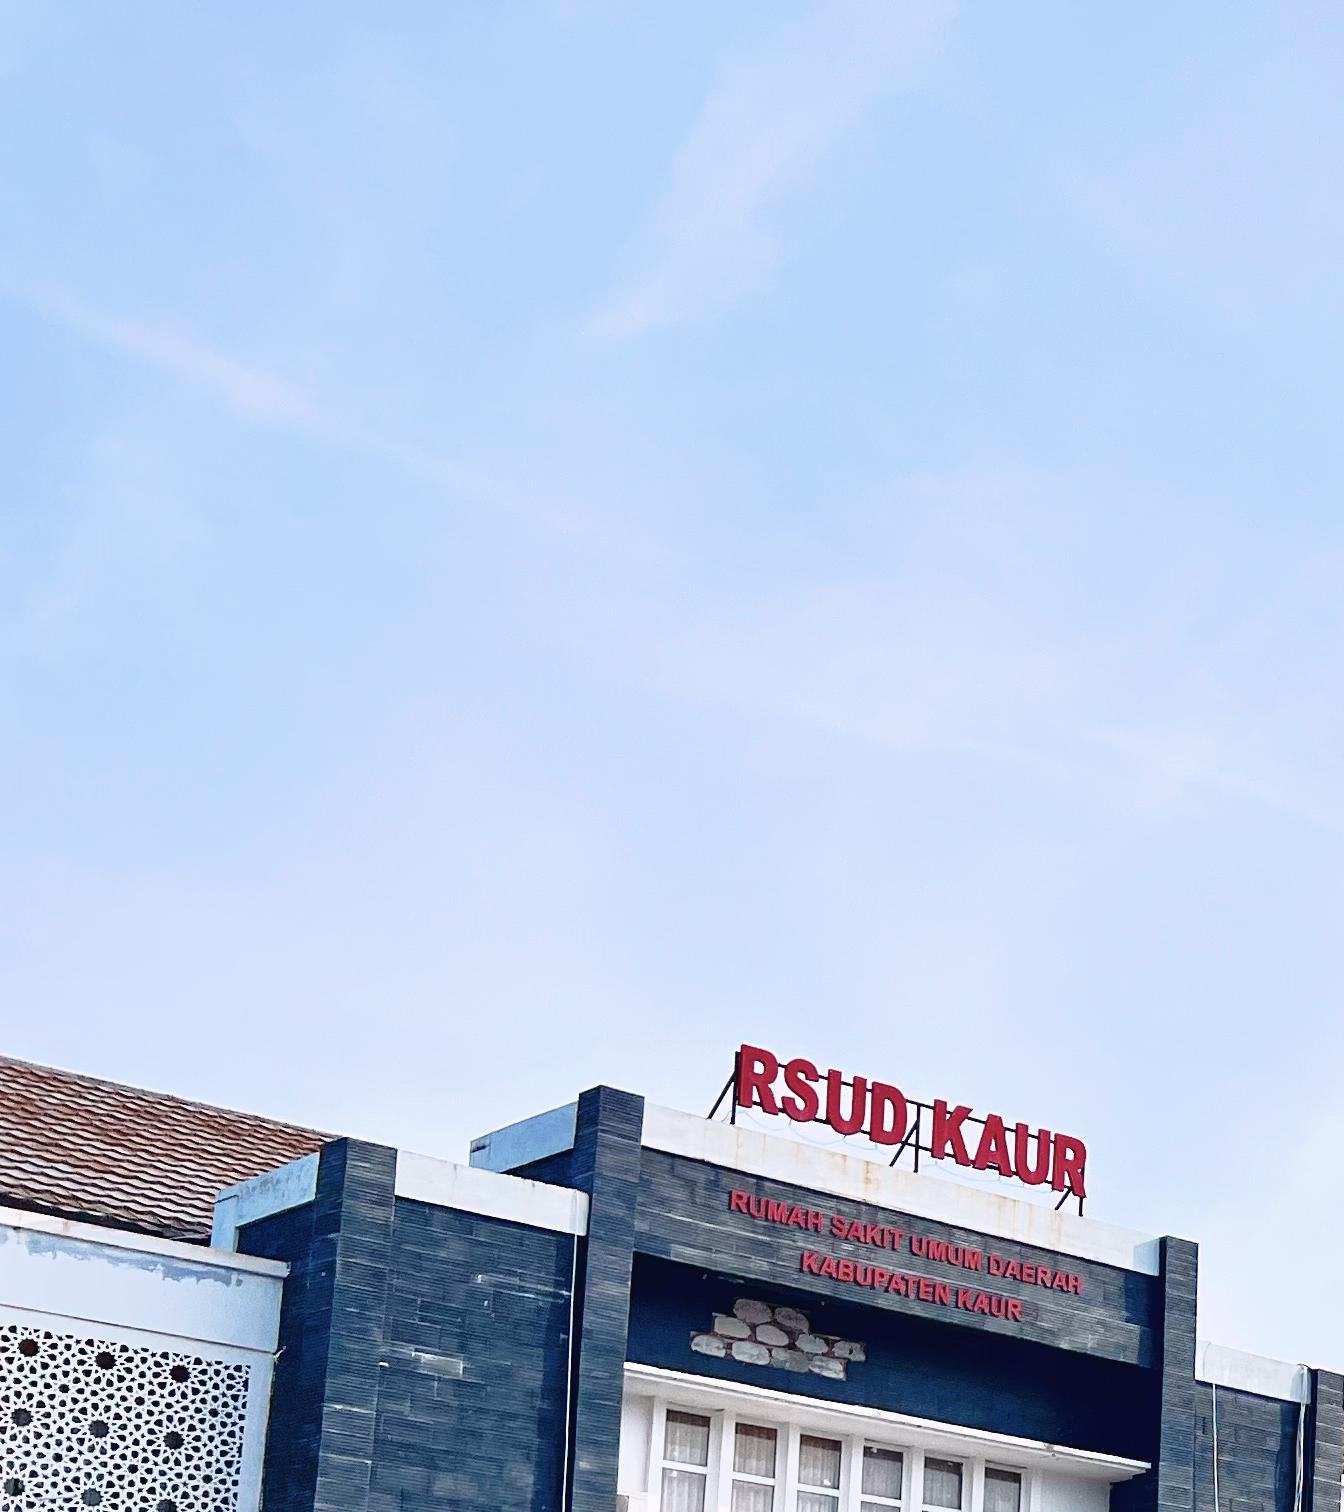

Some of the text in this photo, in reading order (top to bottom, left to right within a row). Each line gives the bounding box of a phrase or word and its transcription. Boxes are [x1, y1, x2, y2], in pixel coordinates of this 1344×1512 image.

[738, 1044, 1087, 1198] RSUD KAUR
[729, 1189, 1084, 1295] RUMAH SAKIT UMUM DAERAH
[801, 1250, 1024, 1321] KABUPATEN KAUR
